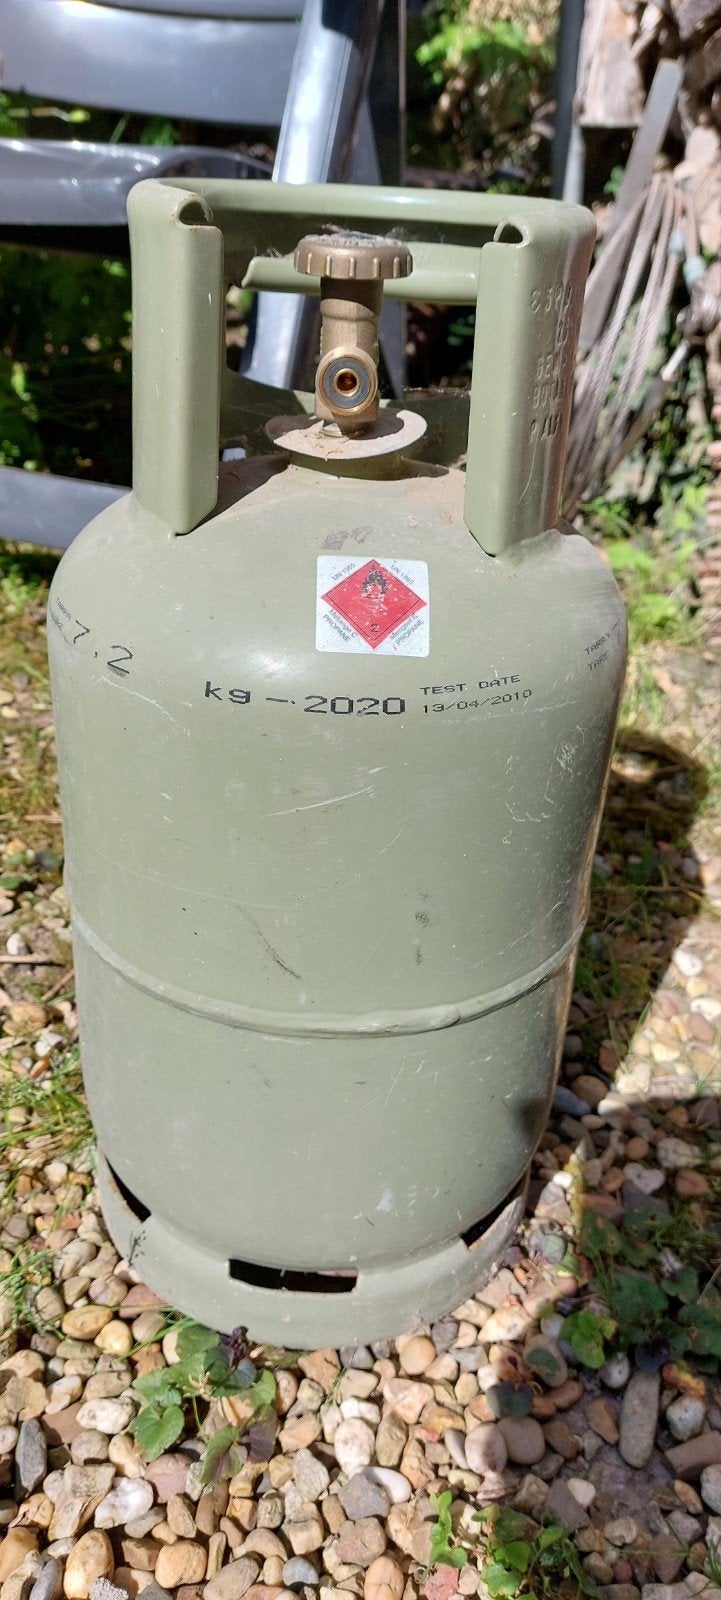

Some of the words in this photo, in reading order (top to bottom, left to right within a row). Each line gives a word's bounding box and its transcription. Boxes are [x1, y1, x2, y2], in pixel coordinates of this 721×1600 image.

[332, 571, 344, 581] UN
[391, 564, 400, 574] UN
[322, 614, 351, 643] PROPANE
[370, 623, 380, 633] 2
[396, 619, 425, 645] PROPANE
[420, 683, 466, 695] TEST
[479, 674, 520, 690] DATE
[205, 681, 250, 704] kg
[304, 695, 405, 716] 2020
[422, 689, 532, 713] 13/04/2010
